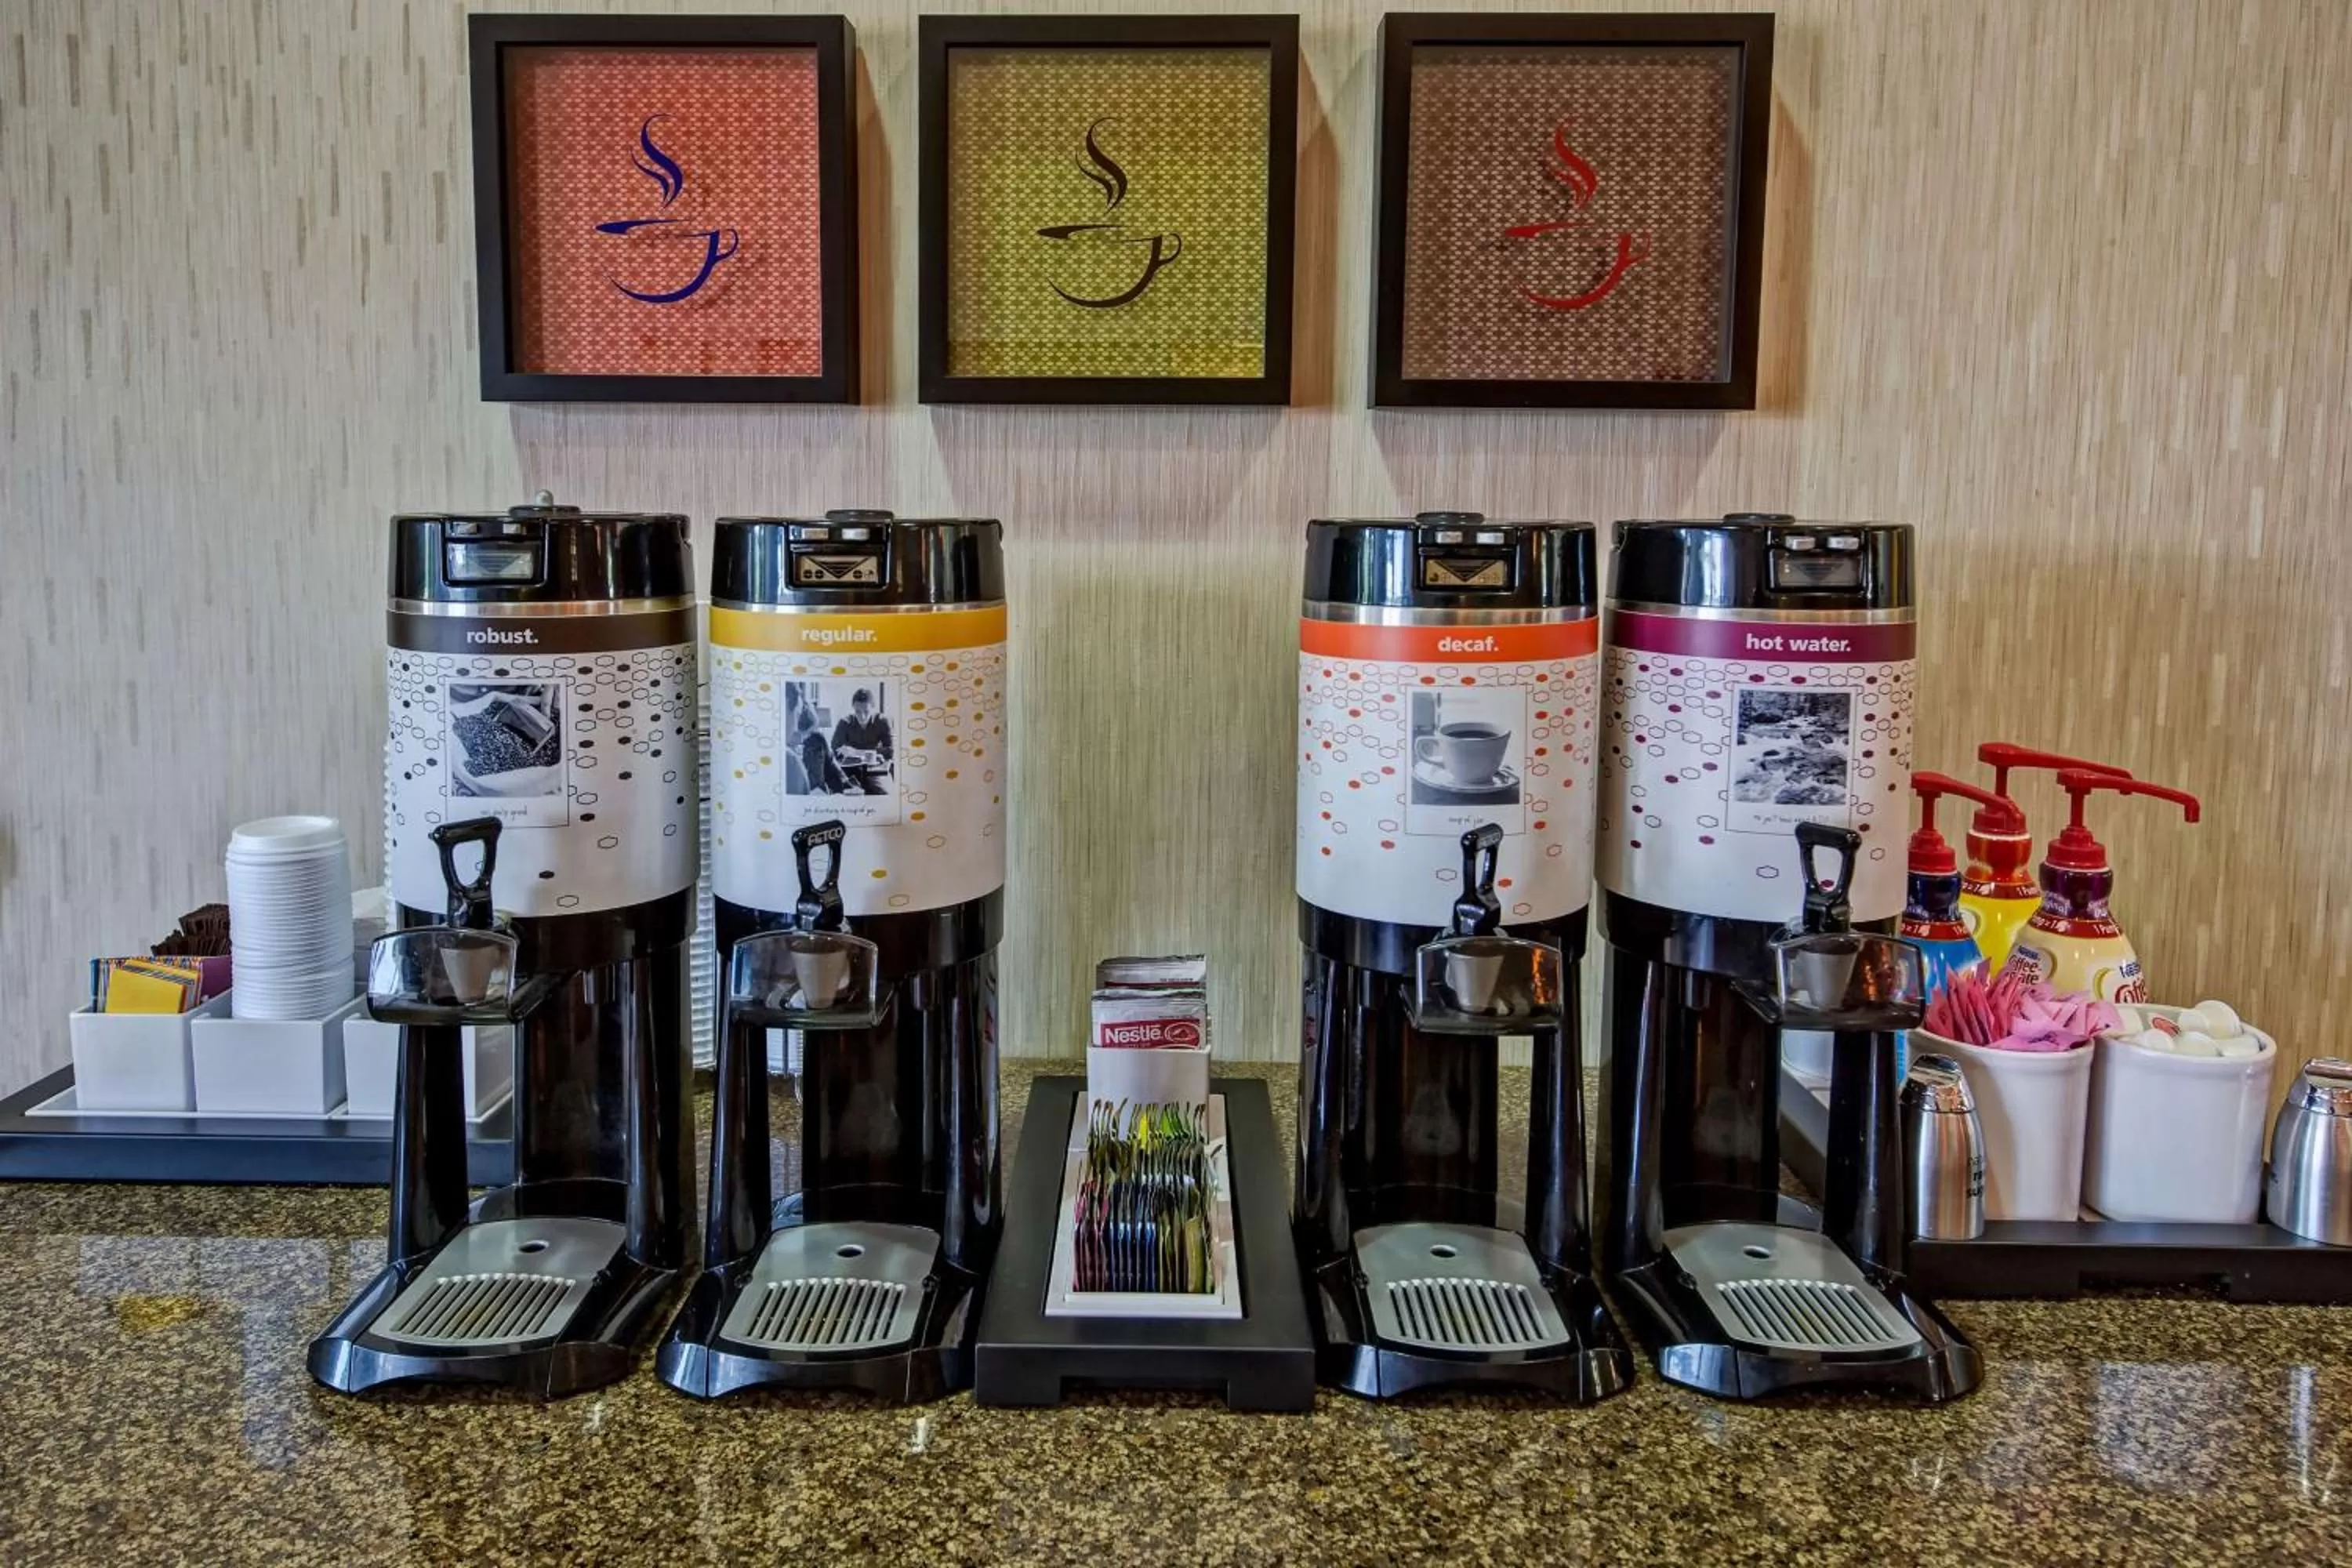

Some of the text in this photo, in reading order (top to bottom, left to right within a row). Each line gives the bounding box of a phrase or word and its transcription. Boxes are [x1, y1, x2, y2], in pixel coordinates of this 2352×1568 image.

[466, 626, 539, 644] robust.
[801, 625, 877, 646] regular.
[1437, 636, 1499, 652] decaf.
[1746, 633, 1852, 652] hot water.
